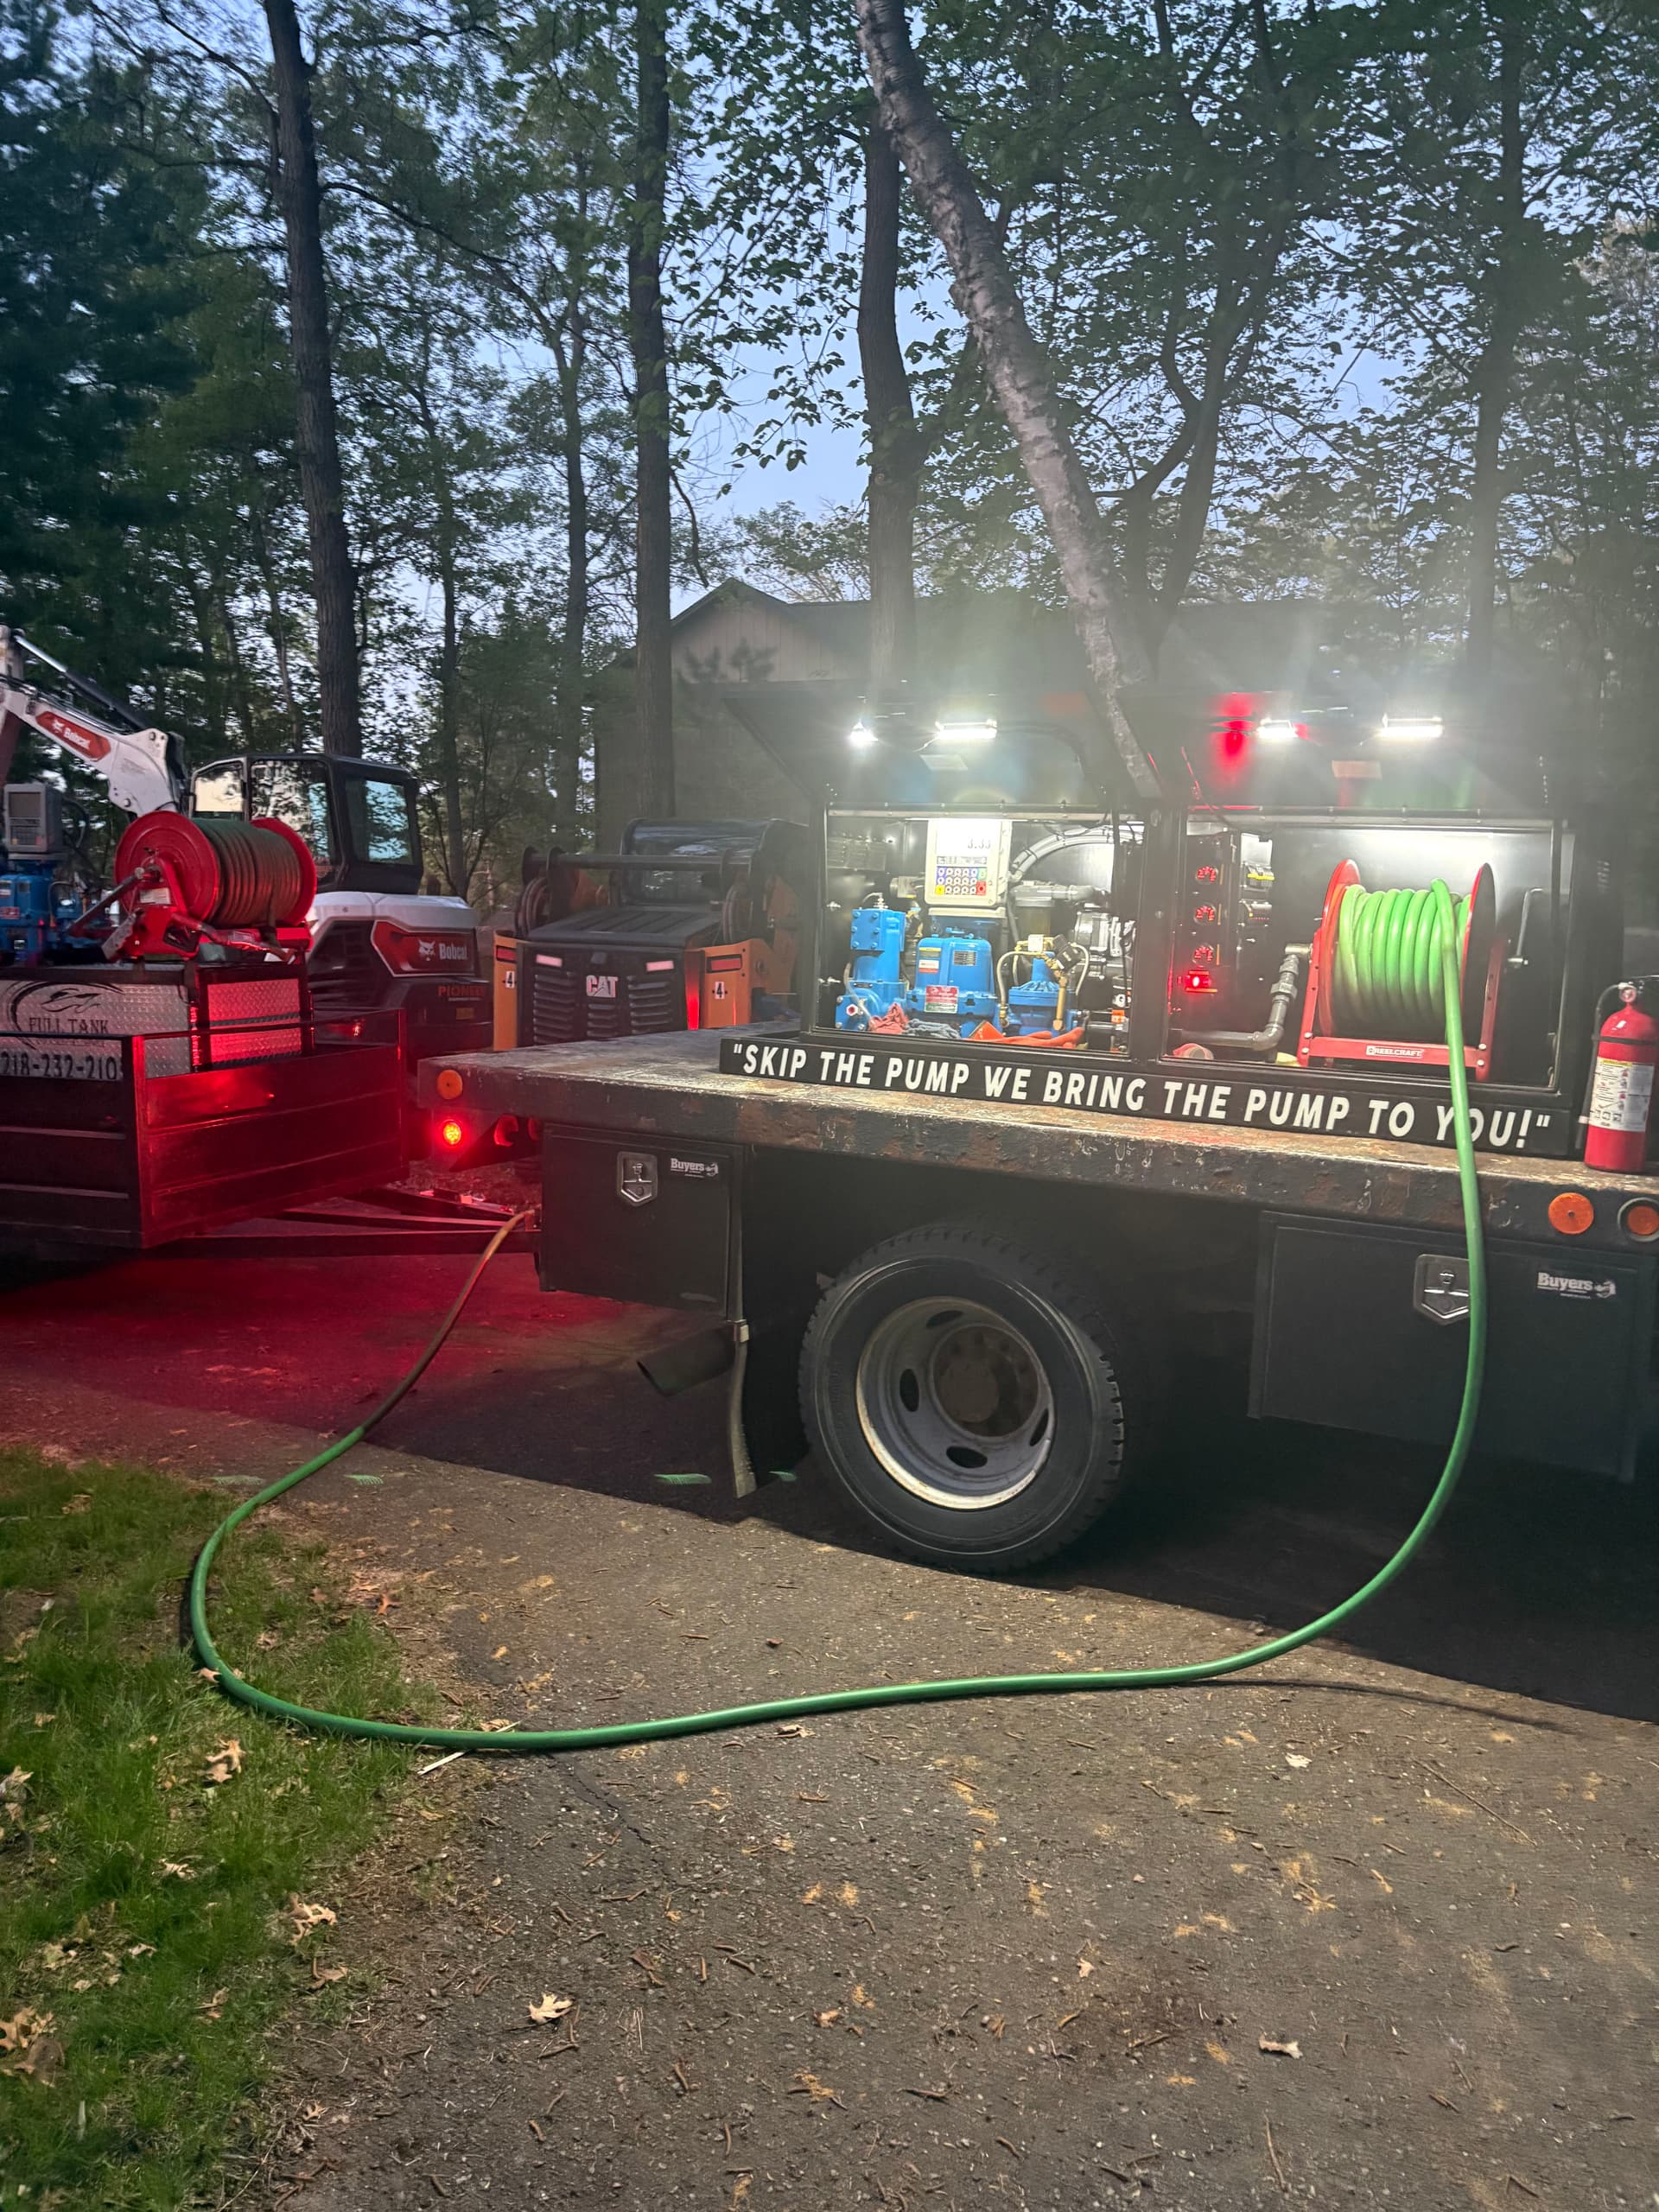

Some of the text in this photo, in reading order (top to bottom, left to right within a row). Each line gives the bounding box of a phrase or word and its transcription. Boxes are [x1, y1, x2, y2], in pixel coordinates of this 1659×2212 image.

[438, 943, 468, 960] Bobcat
[505, 971, 514, 987] 4
[586, 975, 619, 998] CAT
[715, 982, 724, 998] 4
[29, 1017, 109, 1033] FULL TANK
[0, 1051, 124, 1080] 218-232-210
[734, 1043, 807, 1077] "SKIP
[820, 1052, 874, 1085] THE
[885, 1058, 969, 1094] PUMP
[984, 1065, 1032, 1100] WE
[1042, 1071, 1147, 1111] BRING
[1164, 1081, 1231, 1120] THE
[1243, 1089, 1350, 1130] PUMP
[1368, 1099, 1415, 1137] TO
[671, 1158, 705, 1172] Buyers
[1538, 1272, 1593, 1291] Buyers
